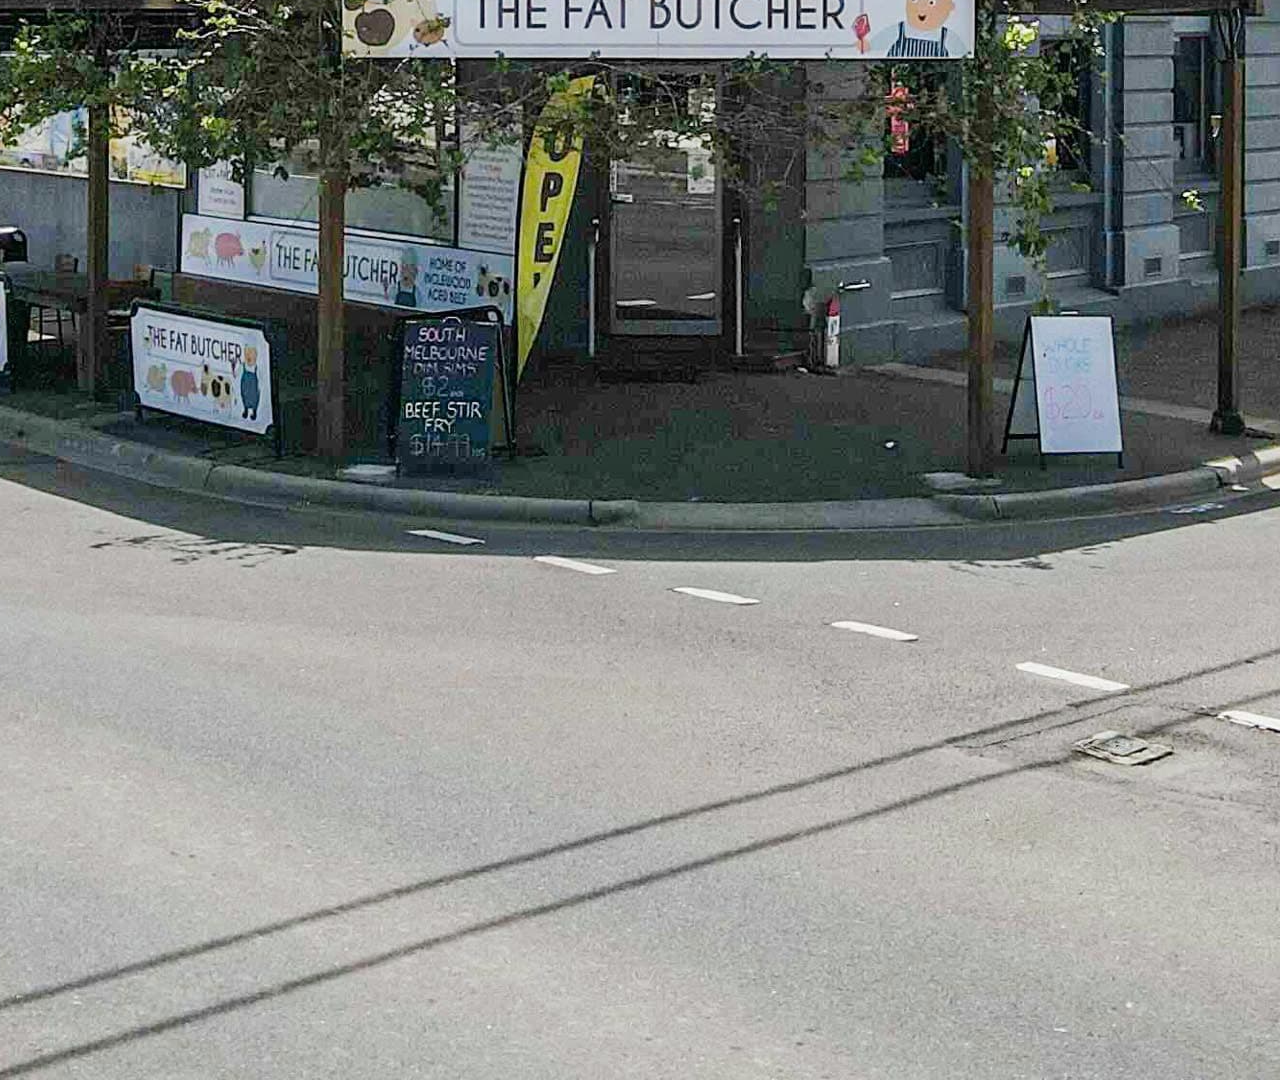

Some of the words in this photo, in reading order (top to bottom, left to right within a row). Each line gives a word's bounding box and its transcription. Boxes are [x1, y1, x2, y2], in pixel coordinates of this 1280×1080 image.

[533, 125, 574, 289] OPE
[276, 243, 300, 270] THE
[304, 249, 320, 272] FA
[343, 255, 399, 284] UTCHER
[429, 256, 453, 272] HOME
[455, 260, 467, 272] OF
[418, 327, 466, 342] SOUTH
[147, 325, 167, 349] THE
[170, 330, 188, 353] FAT
[191, 335, 242, 363] BUTCHER
[405, 345, 489, 361] MELBOURNE
[405, 402, 440, 419] BEEF
[447, 401, 483, 418] STIR
[424, 418, 456, 433] FRY
